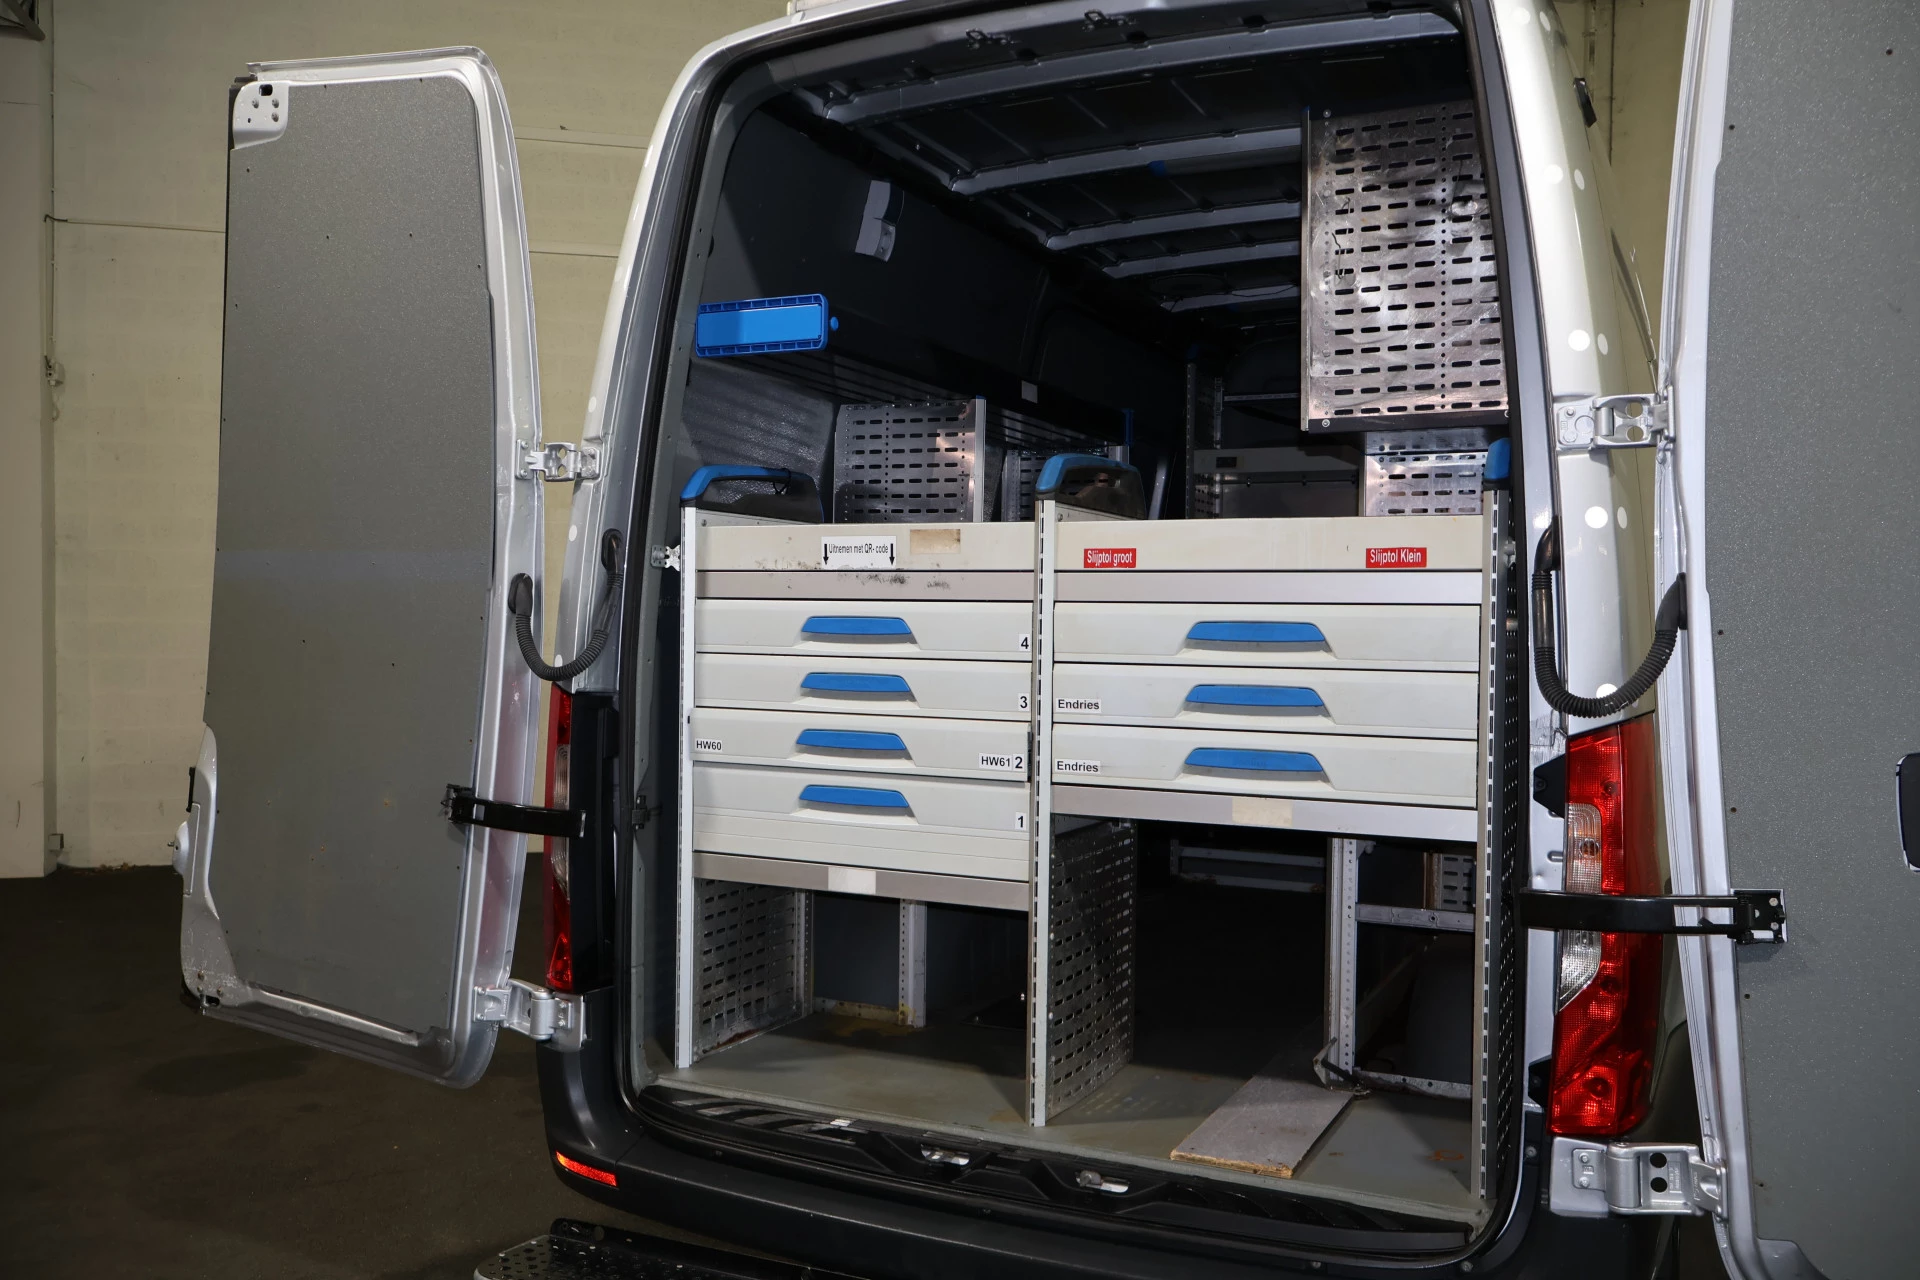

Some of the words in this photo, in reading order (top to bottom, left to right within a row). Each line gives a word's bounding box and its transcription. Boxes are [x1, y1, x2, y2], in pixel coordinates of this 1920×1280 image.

[854, 544, 863, 554] met
[875, 543, 889, 554] code
[1113, 551, 1132, 566] groot
[1370, 549, 1398, 565] Slijptol
[1400, 548, 1421, 562] Klein
[1020, 636, 1029, 650] 4
[1020, 696, 1028, 709] 3
[1058, 699, 1100, 710] Endries
[696, 740, 721, 750] HW60
[981, 756, 1010, 767] HW61
[1014, 756, 1023, 769] 2
[1057, 760, 1099, 772] Endries
[1017, 815, 1023, 828] 1
